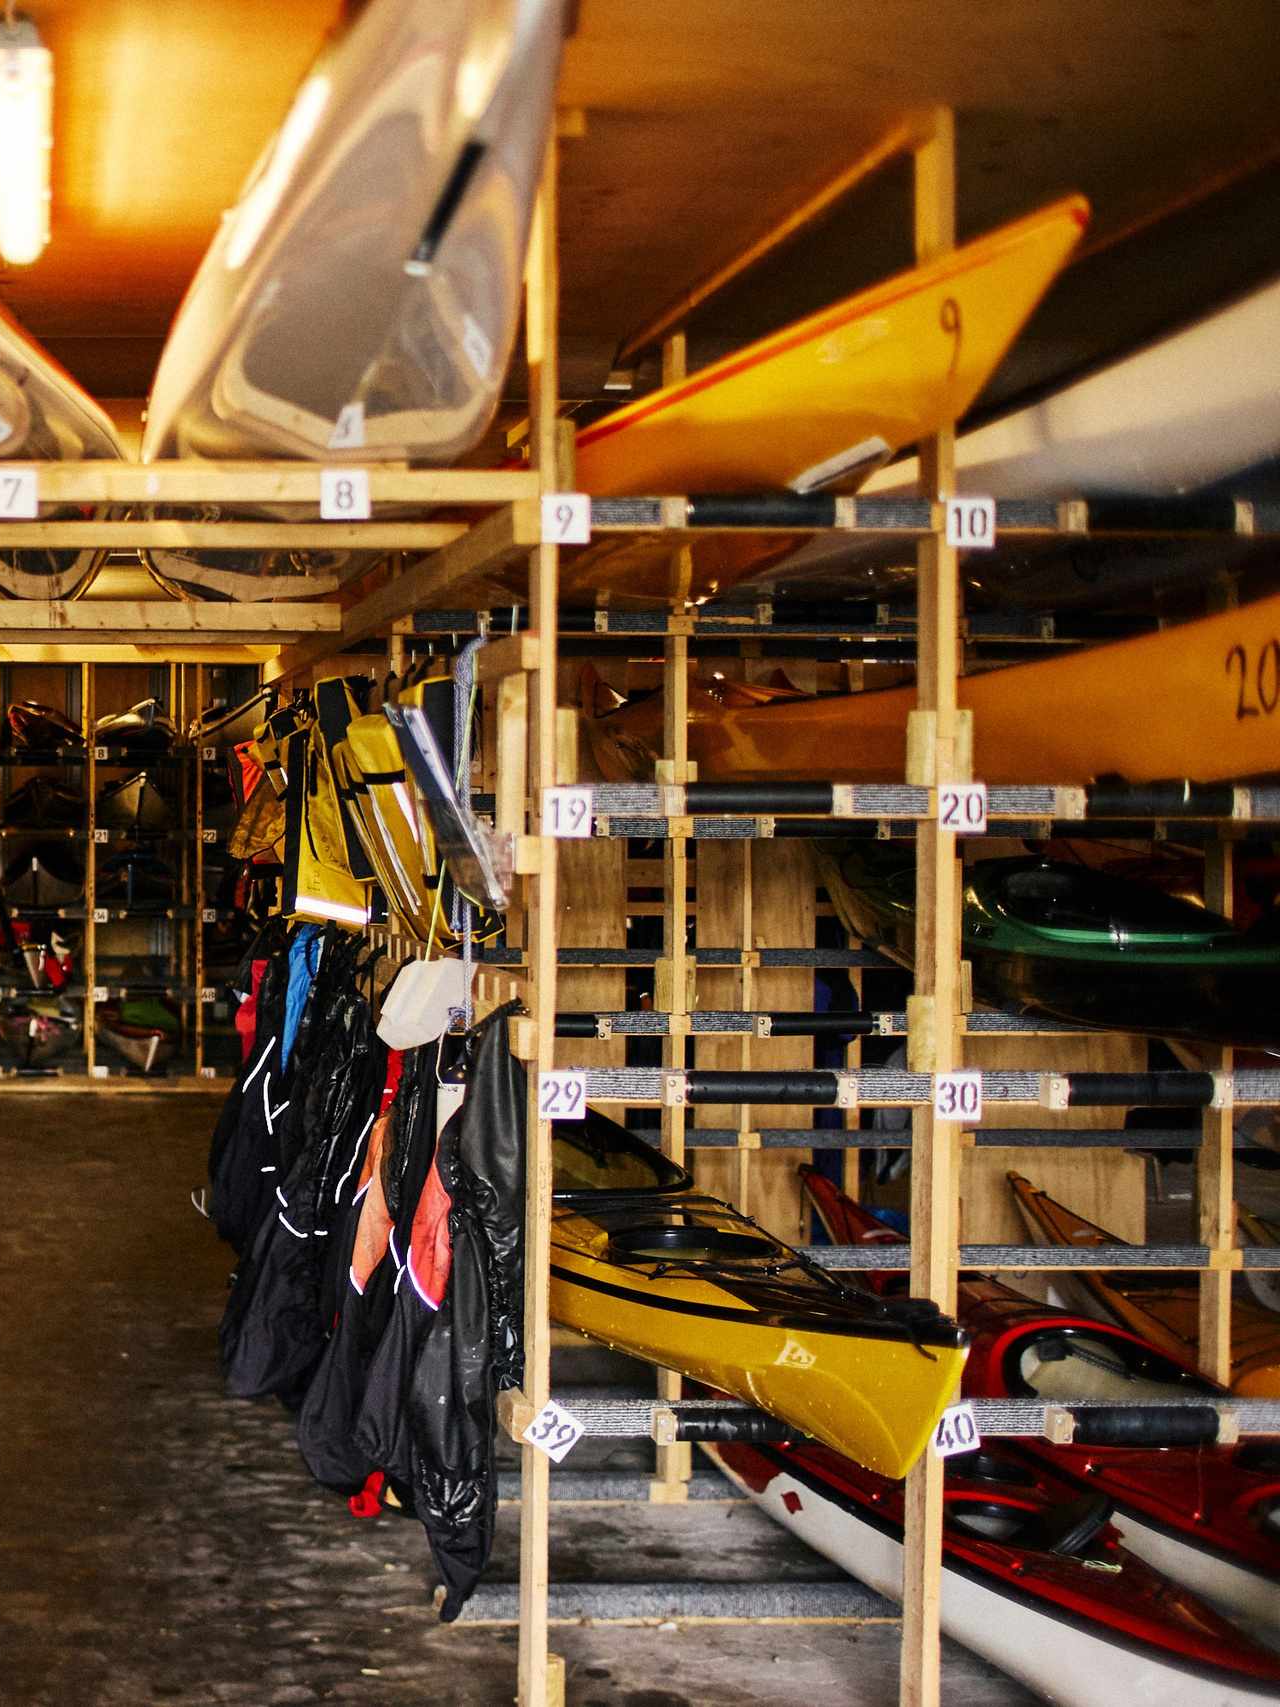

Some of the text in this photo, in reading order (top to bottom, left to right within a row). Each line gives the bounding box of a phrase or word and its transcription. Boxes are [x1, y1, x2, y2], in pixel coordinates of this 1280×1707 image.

[939, 297, 963, 380] 9
[2, 477, 23, 510] 7
[335, 480, 355, 510] 8
[554, 505, 575, 536] 9
[953, 506, 988, 538] 10
[1225, 637, 1280, 721] 20
[98, 749, 105, 759] 8
[205, 749, 213, 759] 9
[550, 797, 588, 830] 19
[942, 793, 984, 825] 20
[96, 831, 107, 842] 21
[203, 831, 215, 842] 22
[541, 1080, 583, 1113] 29
[939, 1082, 979, 1113] 30
[532, 1410, 577, 1450] 39
[936, 1412, 975, 1449] 40
